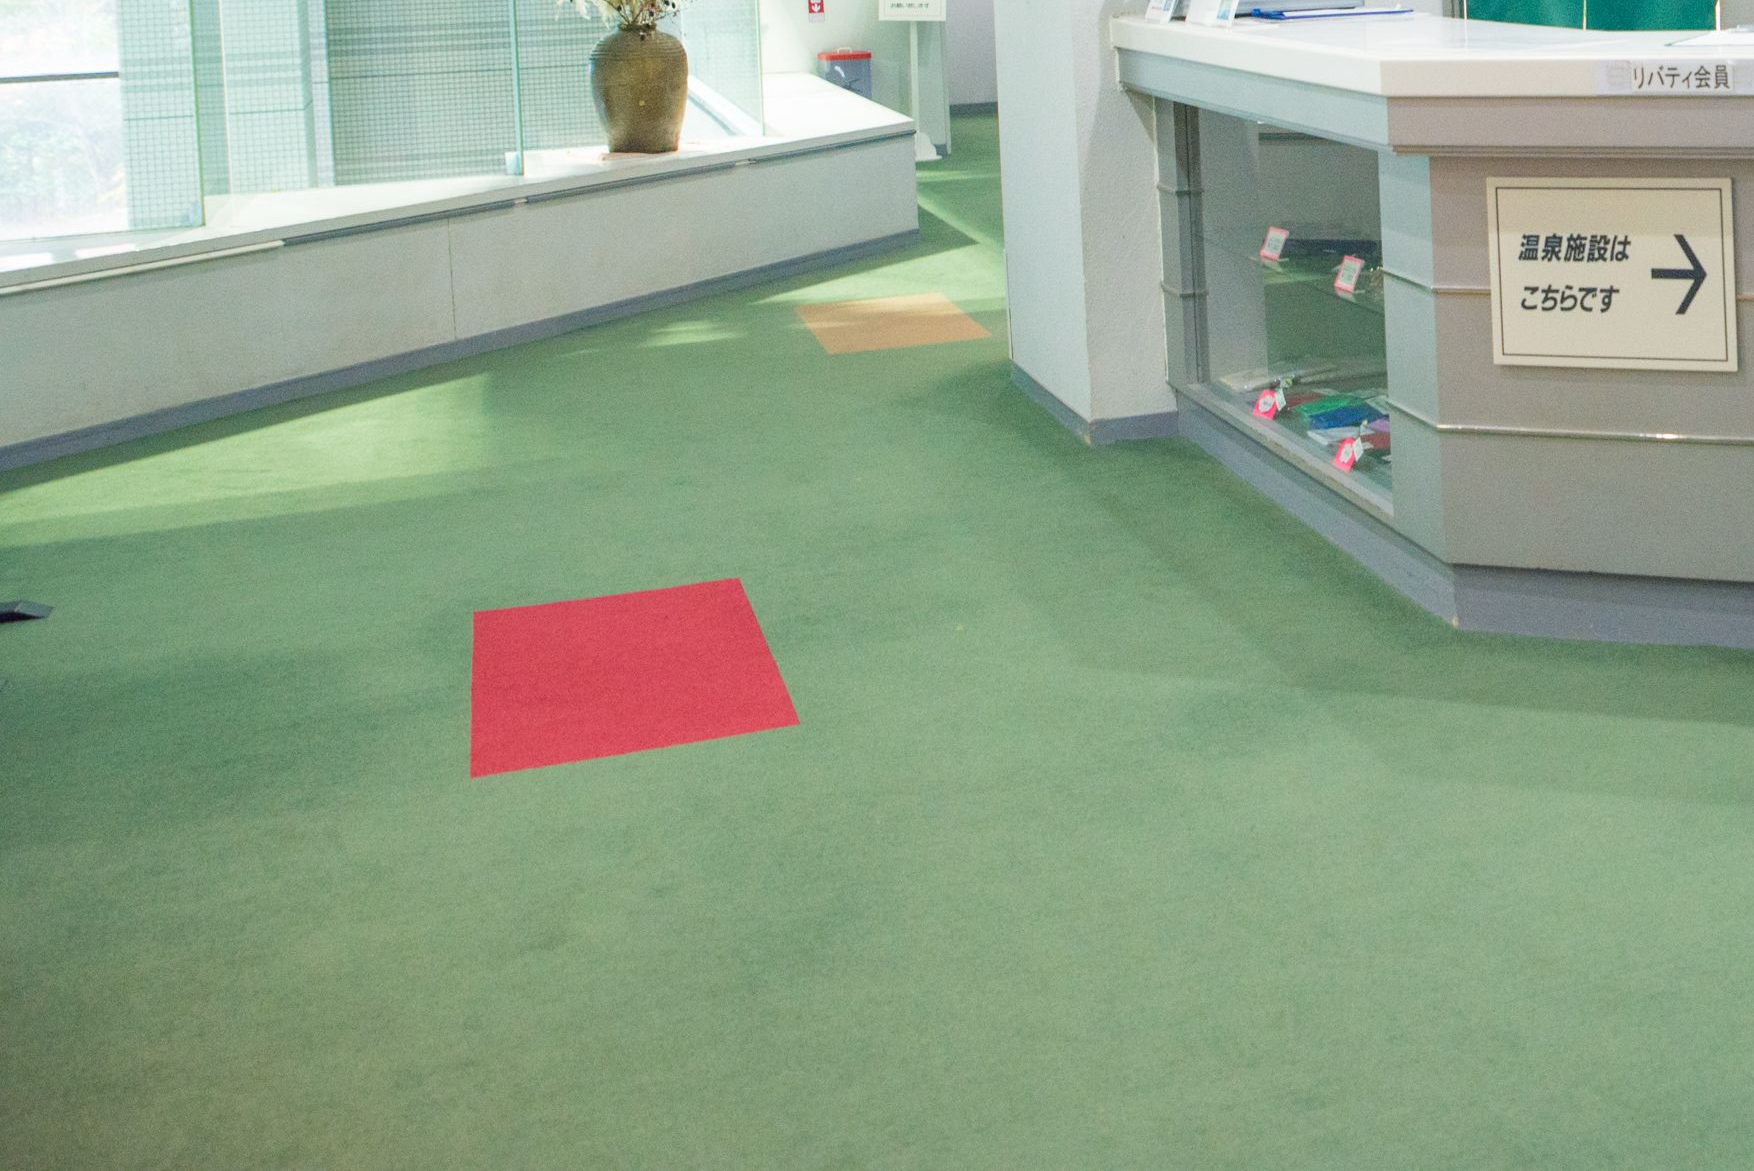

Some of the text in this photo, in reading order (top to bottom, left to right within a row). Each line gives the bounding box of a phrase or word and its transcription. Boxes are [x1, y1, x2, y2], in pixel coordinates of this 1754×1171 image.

[1633, 64, 1730, 89] リバティ会員
[1518, 233, 1632, 263] 温泉施設は
[1520, 284, 1620, 313] こちらです
